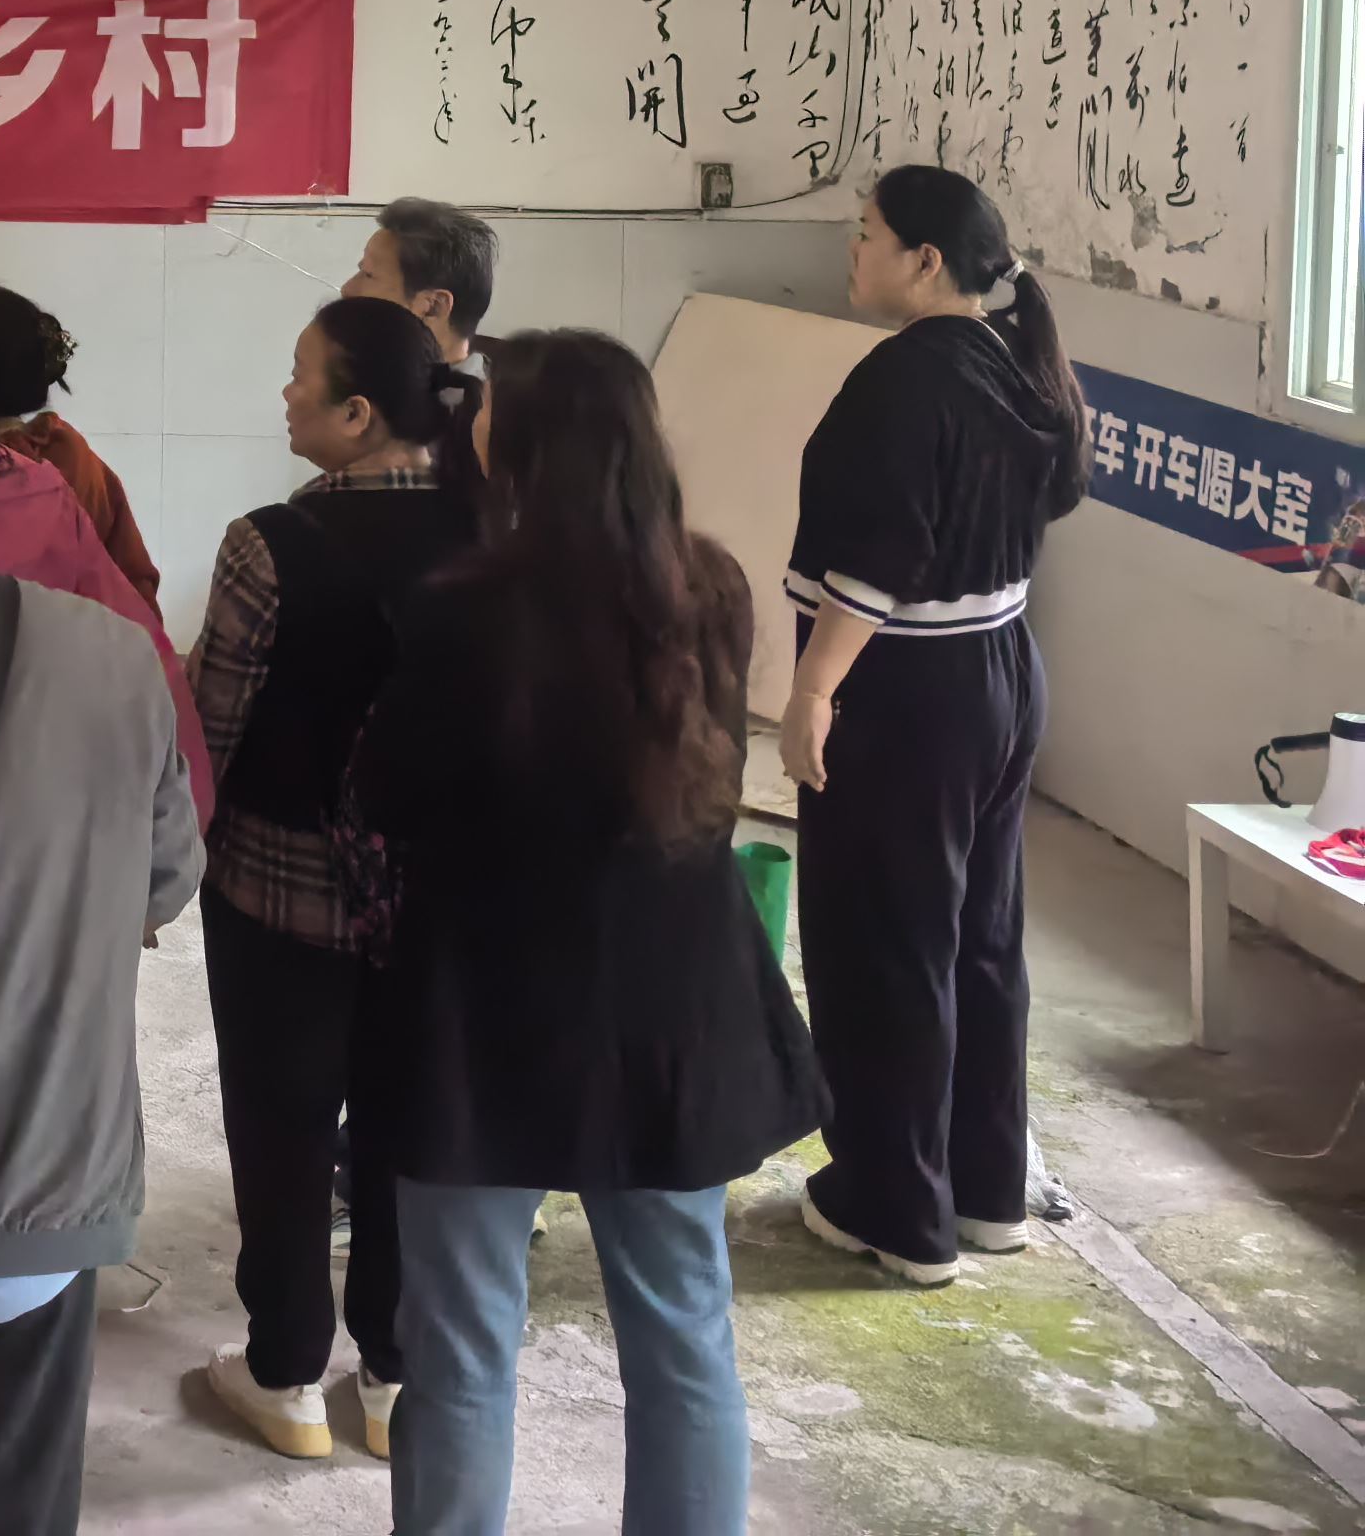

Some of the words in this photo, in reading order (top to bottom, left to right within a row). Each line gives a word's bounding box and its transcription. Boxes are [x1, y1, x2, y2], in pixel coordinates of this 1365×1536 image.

[1085, 406, 1128, 475] 车
[1133, 421, 1314, 546] 开车喝大窑
